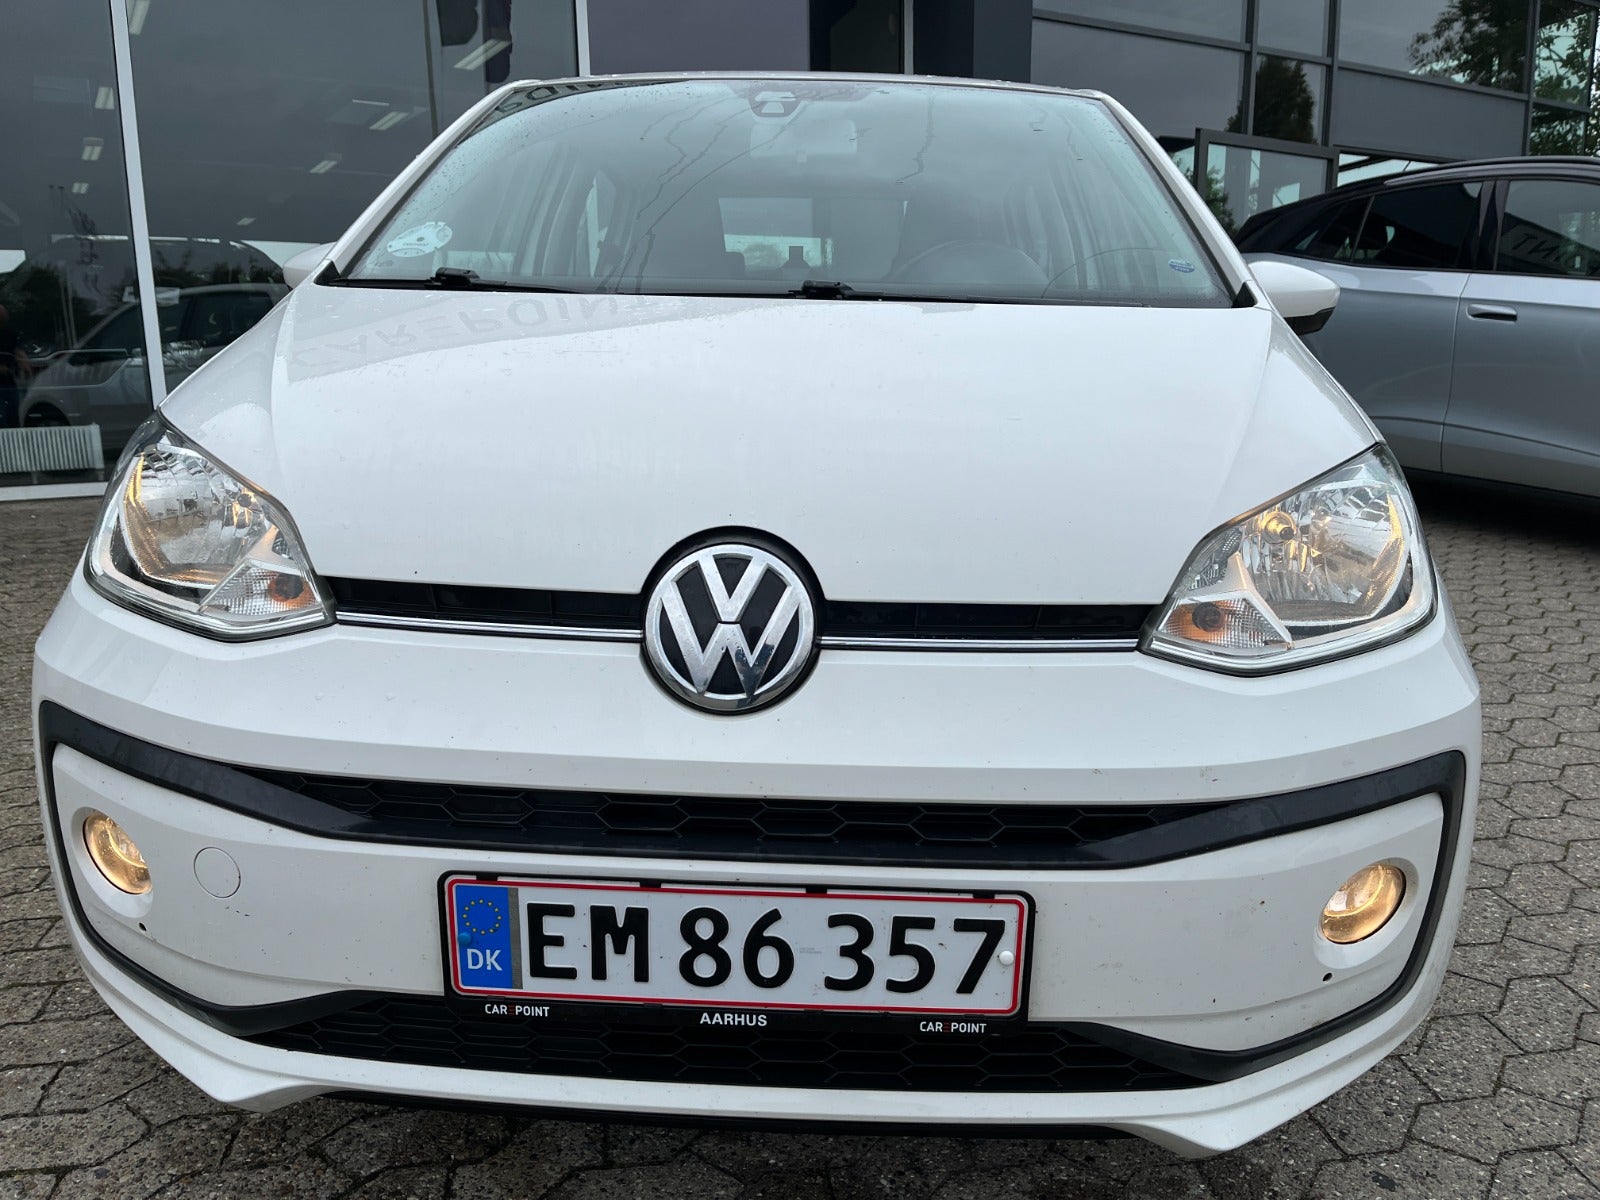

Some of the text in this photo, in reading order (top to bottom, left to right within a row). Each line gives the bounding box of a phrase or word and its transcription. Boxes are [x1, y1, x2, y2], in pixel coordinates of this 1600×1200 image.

[466, 948, 503, 972] DK
[526, 902, 1006, 995] EM 86 357
[699, 1011, 768, 1028] AARHUS
